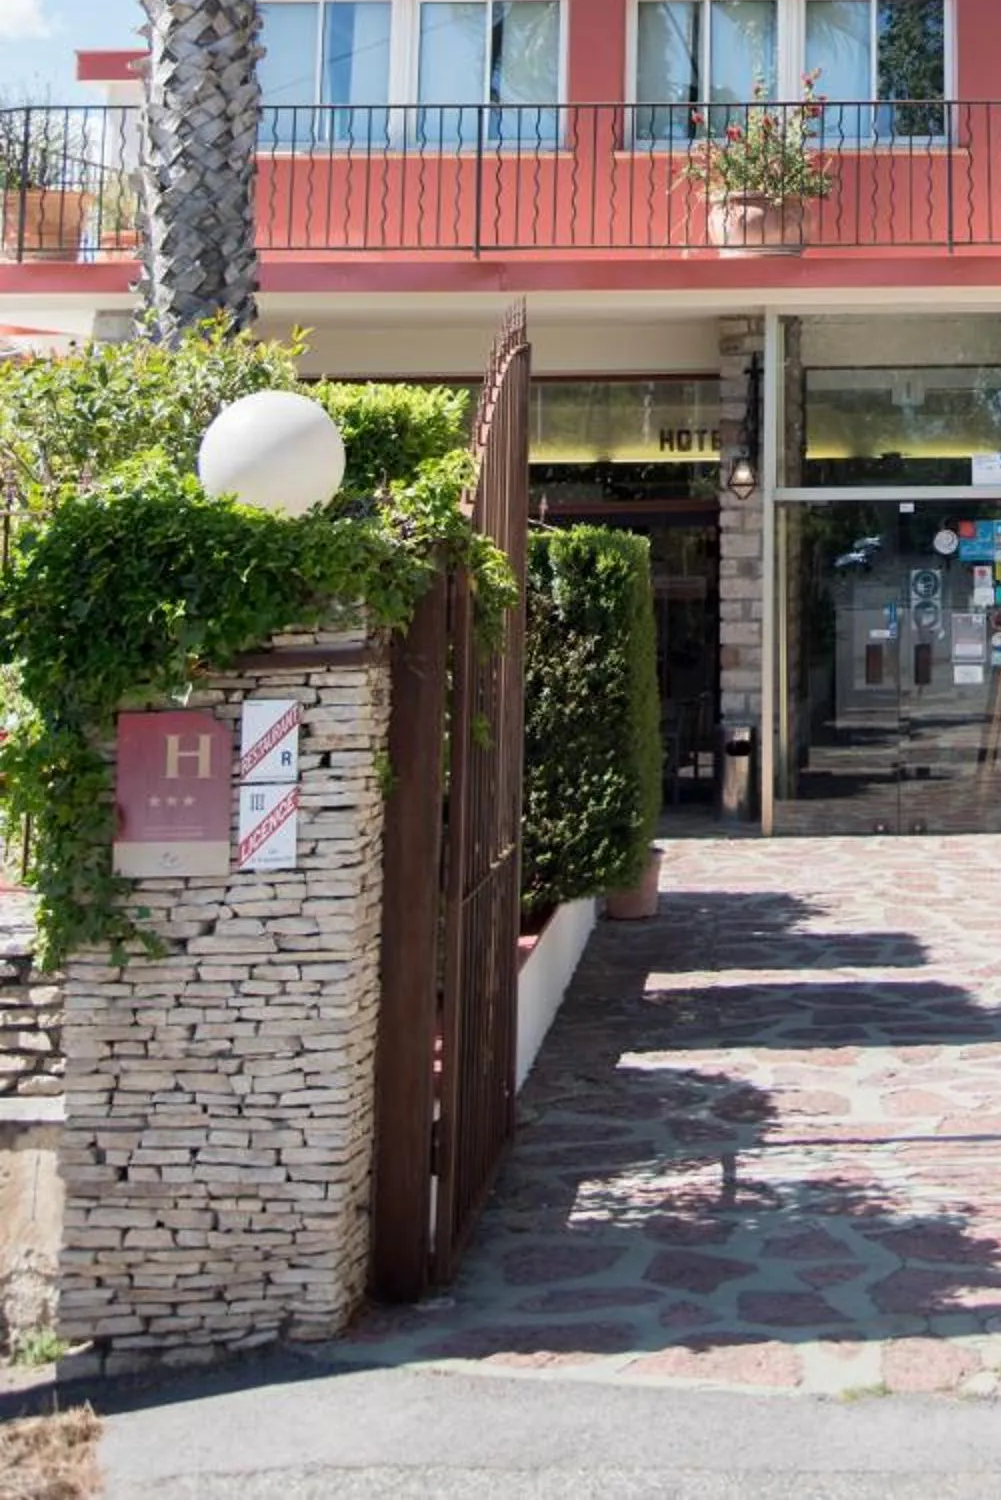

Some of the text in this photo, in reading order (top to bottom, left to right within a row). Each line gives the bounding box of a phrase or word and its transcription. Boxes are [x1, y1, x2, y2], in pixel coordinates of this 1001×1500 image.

[659, 429, 721, 452] HOTE
[160, 733, 217, 779] H
[281, 749, 292, 767] R
[241, 789, 297, 862] LICENCE
